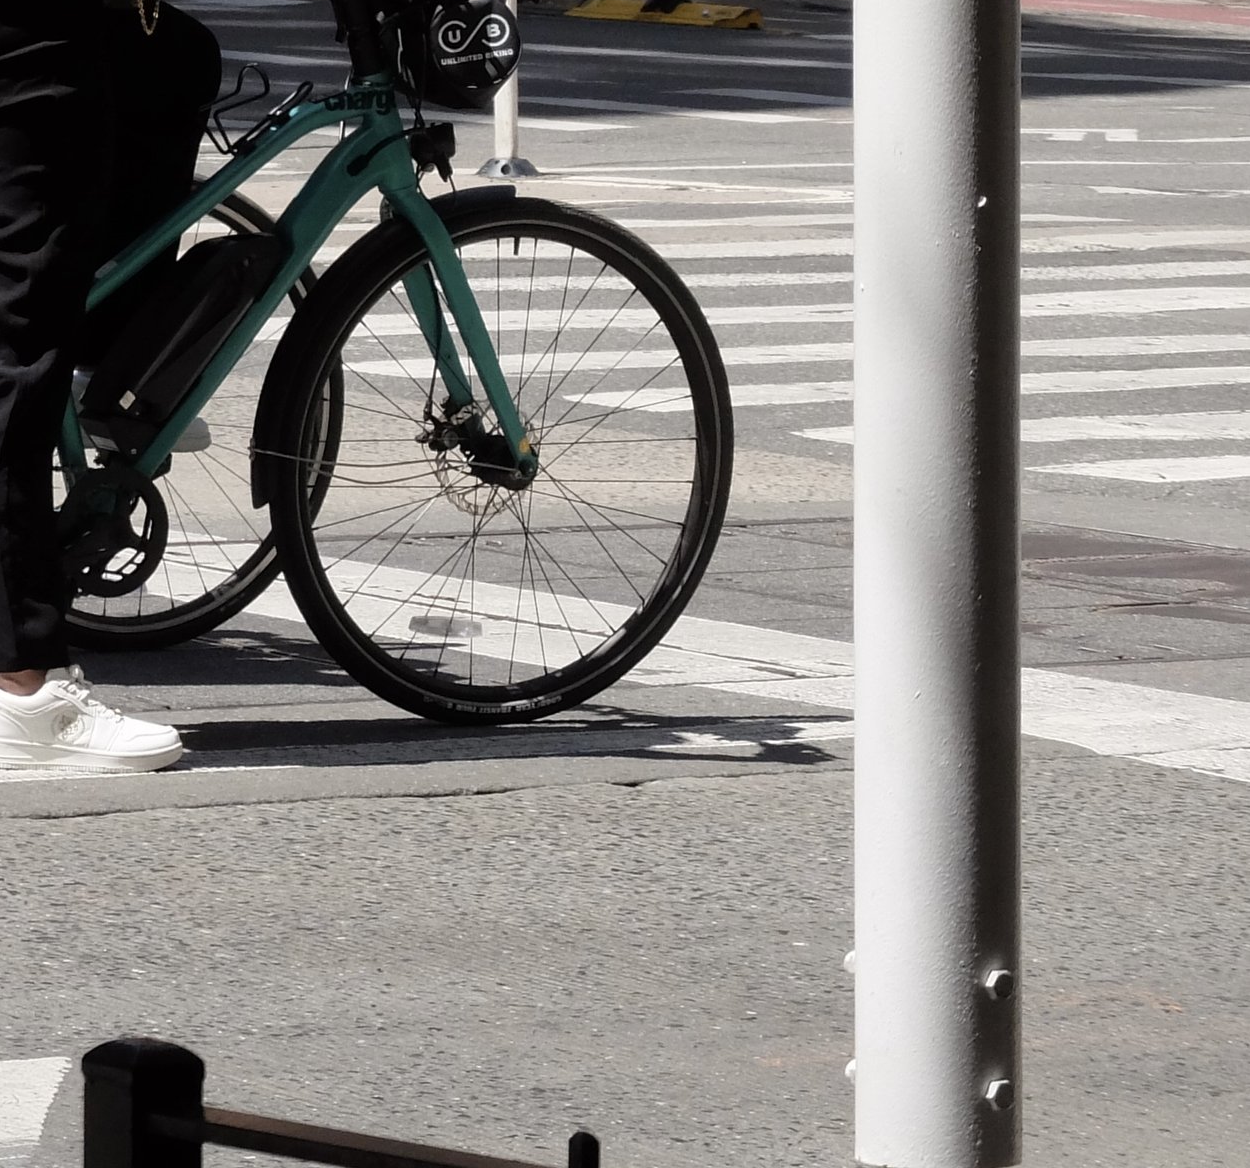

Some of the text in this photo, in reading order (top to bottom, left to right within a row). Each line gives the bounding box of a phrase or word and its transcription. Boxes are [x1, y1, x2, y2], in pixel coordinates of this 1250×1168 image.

[448, 23, 501, 43] U B
[440, 48, 514, 66] UNLIMITED BIKING
